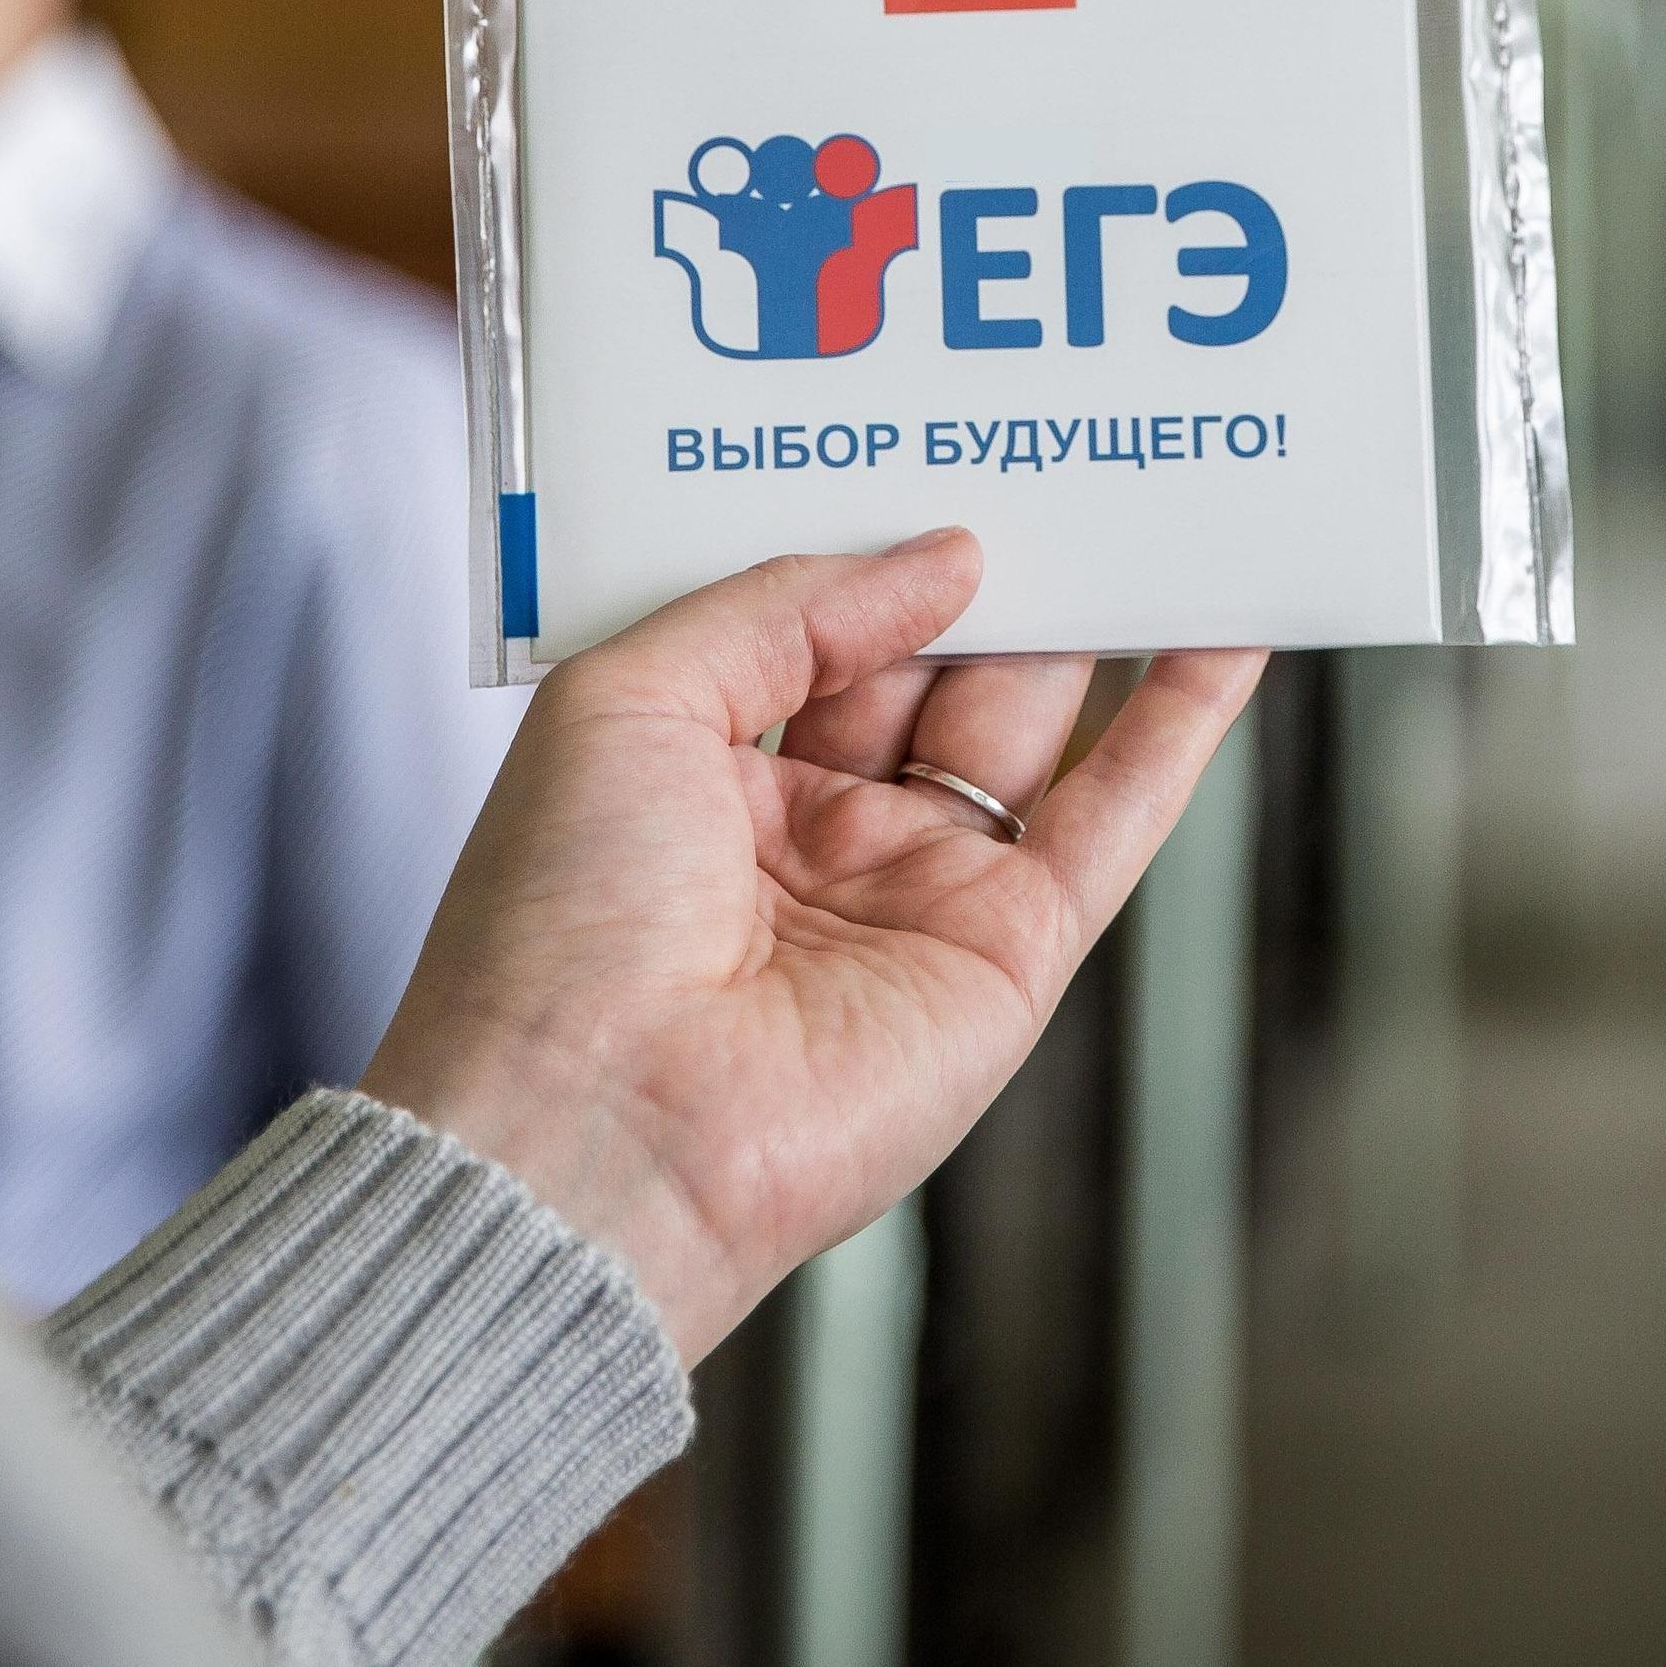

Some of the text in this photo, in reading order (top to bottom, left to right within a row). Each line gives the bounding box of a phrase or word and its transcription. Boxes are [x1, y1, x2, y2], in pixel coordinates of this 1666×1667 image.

[939, 180, 1288, 350] ЕГЭ
[668, 414, 1286, 472] ВЫБОР БУДУЩЕГО!
